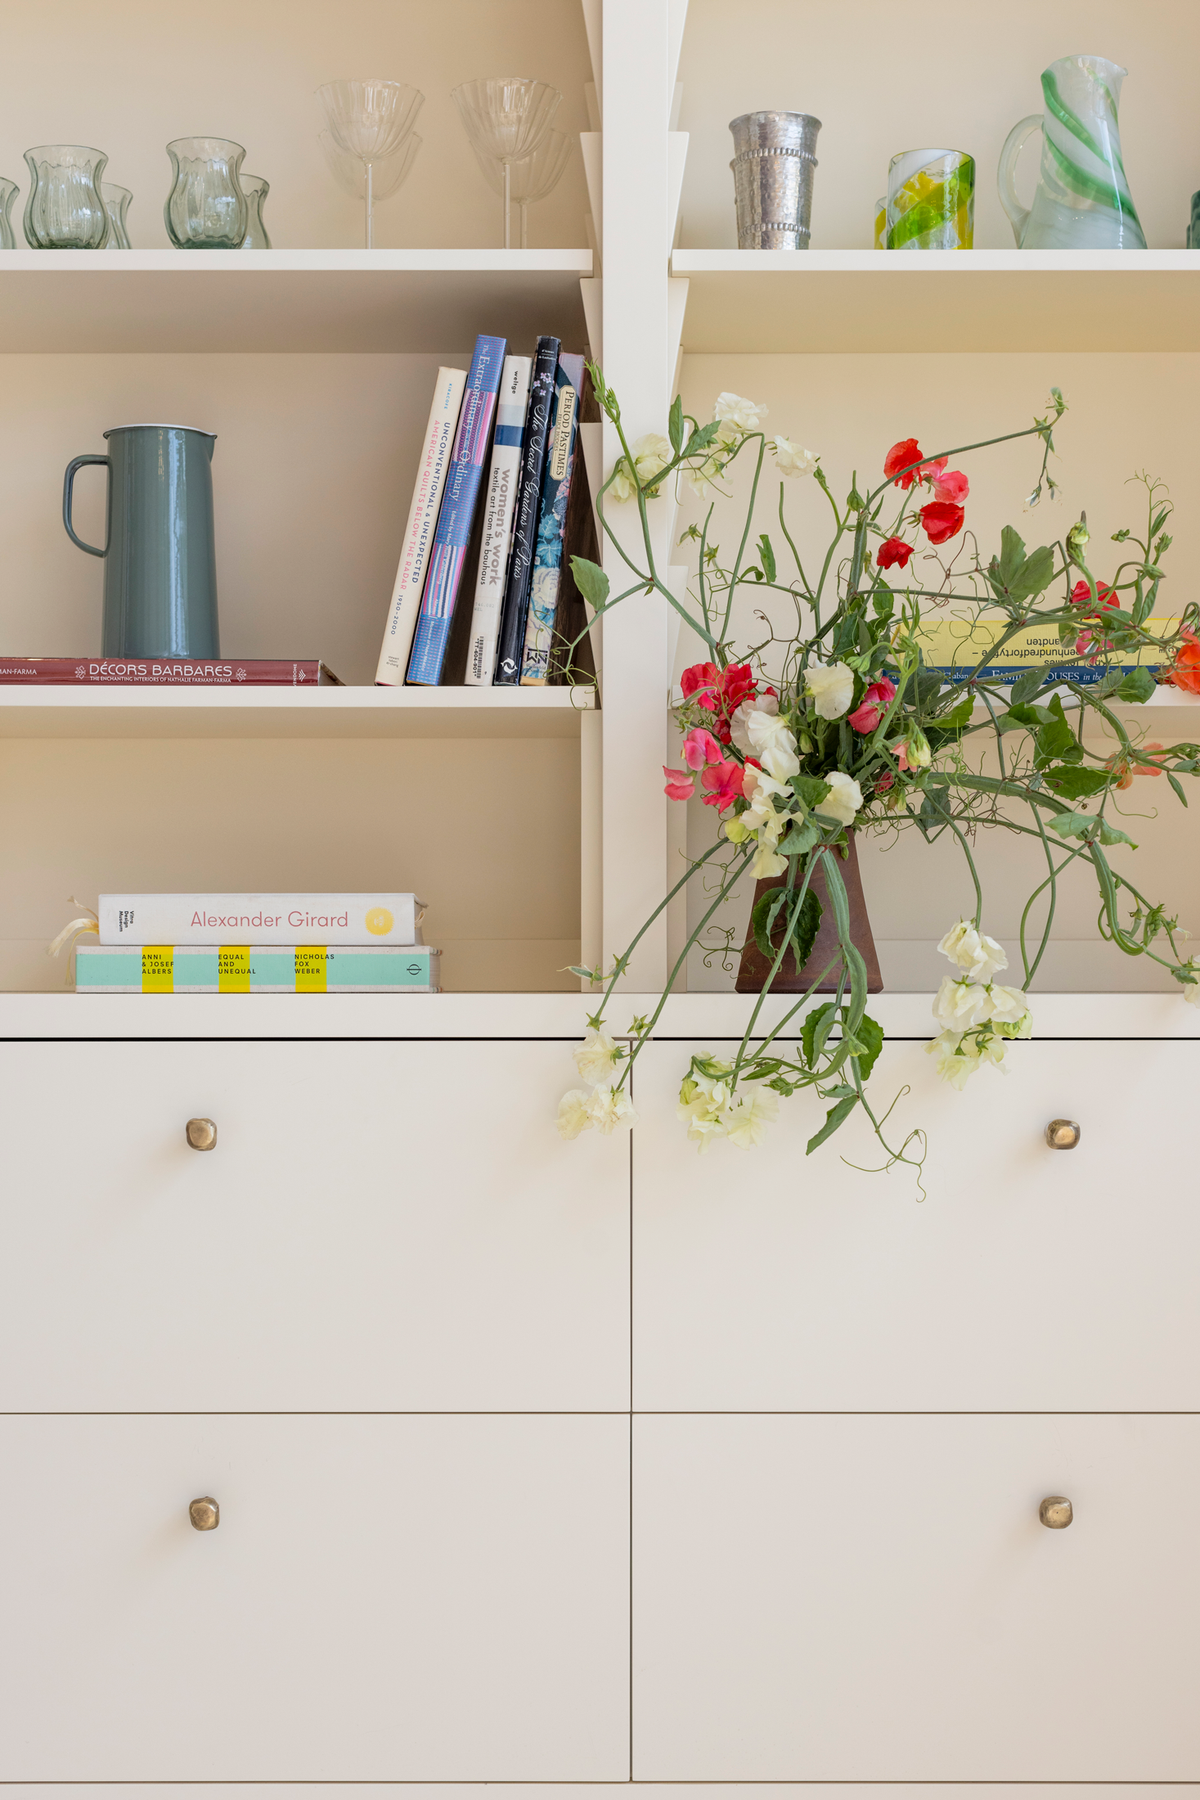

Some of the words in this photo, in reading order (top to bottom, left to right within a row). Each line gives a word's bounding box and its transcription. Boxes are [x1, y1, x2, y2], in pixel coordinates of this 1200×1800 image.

[462, 356, 490, 429] Extraordinary
[511, 371, 519, 394] weltge
[532, 404, 548, 431] The
[562, 391, 575, 429] PERIOD
[426, 420, 440, 467] AMERICAN
[527, 435, 543, 474] Secret
[557, 430, 570, 476] PASTIMES
[427, 422, 450, 509] UNCONVENTIONAL
[449, 450, 470, 501] Ordinary
[491, 467, 500, 493] textile
[418, 470, 431, 503] QUILTS
[520, 477, 540, 527] Gardens
[412, 506, 423, 538] BELOW
[487, 511, 497, 531] from
[407, 541, 416, 558] THE
[412, 521, 430, 583] UNEXPECTED
[484, 533, 493, 546] the
[516, 530, 529, 548] of
[401, 561, 412, 590] RADAR
[480, 549, 492, 585] bauhaus
[489, 544, 502, 585] work
[514, 546, 532, 580] Paris
[89, 661, 147, 675] DÉCORS
[152, 665, 233, 677] BARBARES
[1046, 672, 1080, 681] OUSES
[1083, 672, 1090, 681] in
[1092, 672, 1102, 681] the
[191, 911, 282, 927] Alexander
[287, 911, 348, 927] Girard
